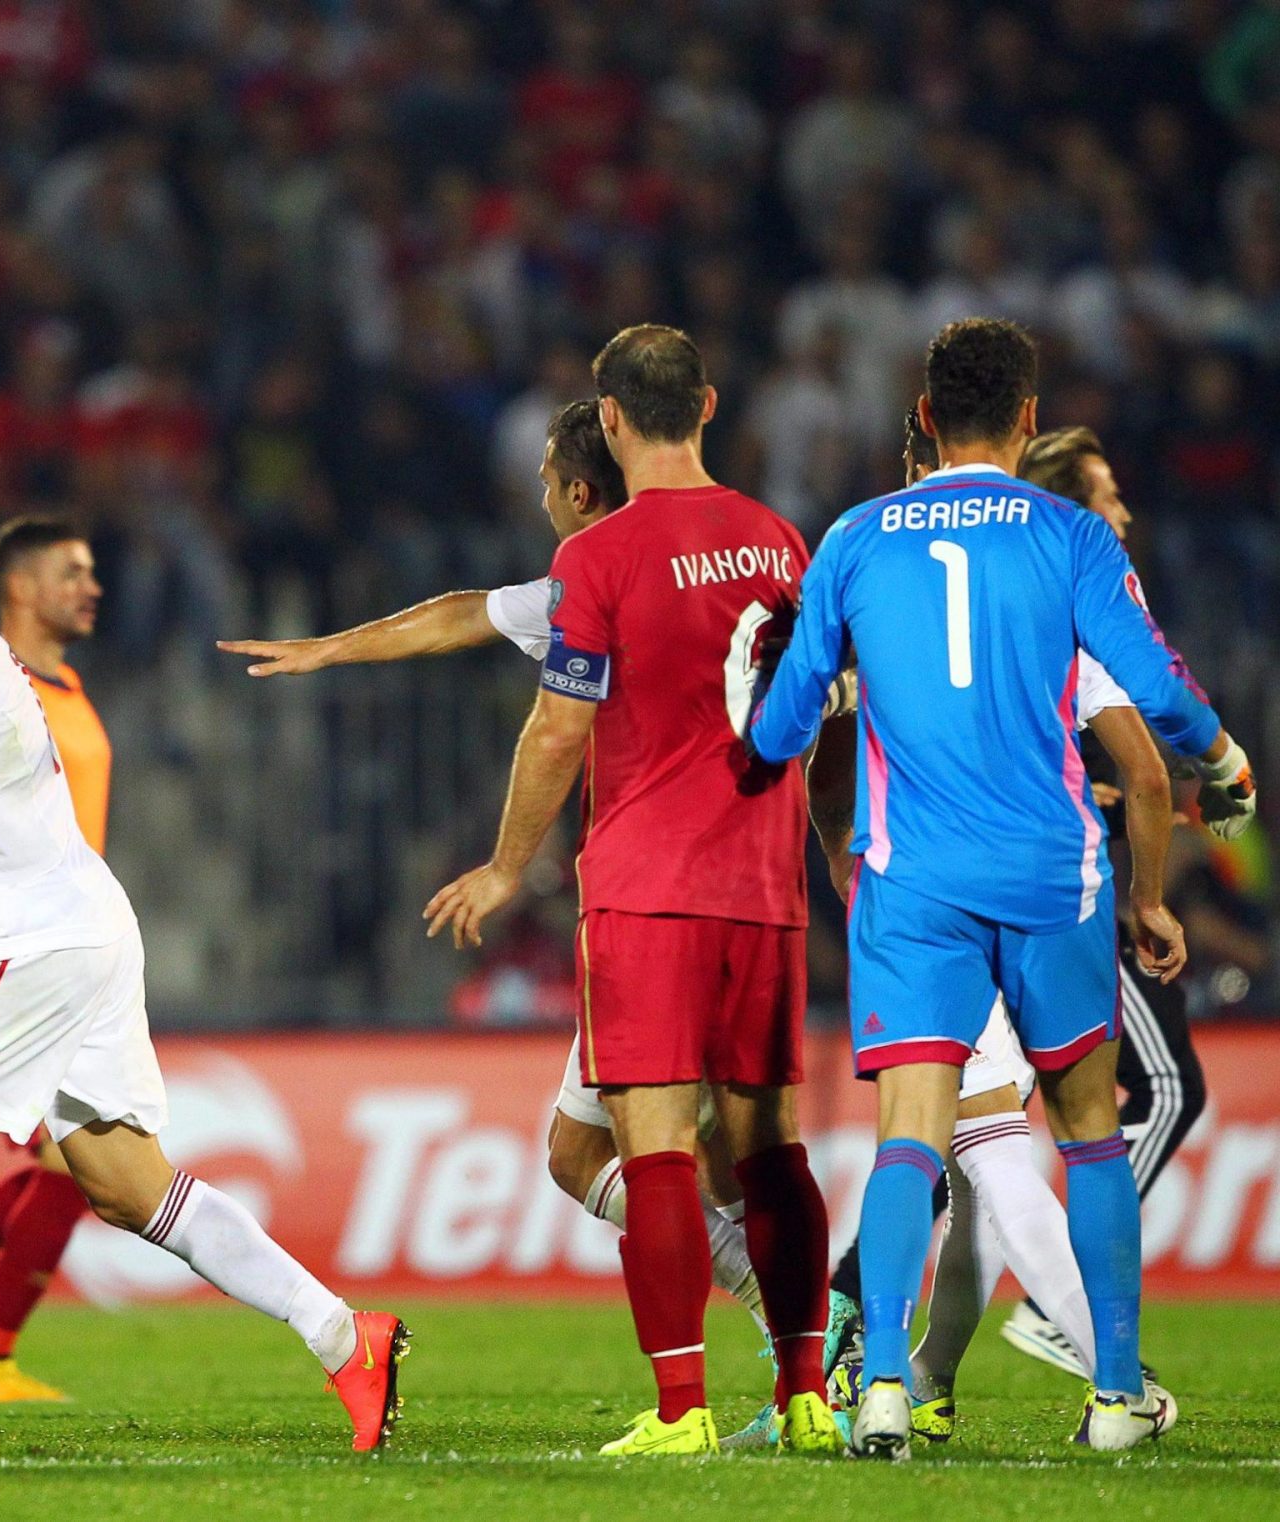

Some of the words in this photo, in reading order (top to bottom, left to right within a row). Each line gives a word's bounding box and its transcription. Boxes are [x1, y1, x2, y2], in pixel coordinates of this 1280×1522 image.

[881, 496, 1031, 533] BERISHA
[670, 545, 792, 590] IVANOVIĆ
[928, 539, 973, 689] 1
[964, 1054, 990, 1069] didas
